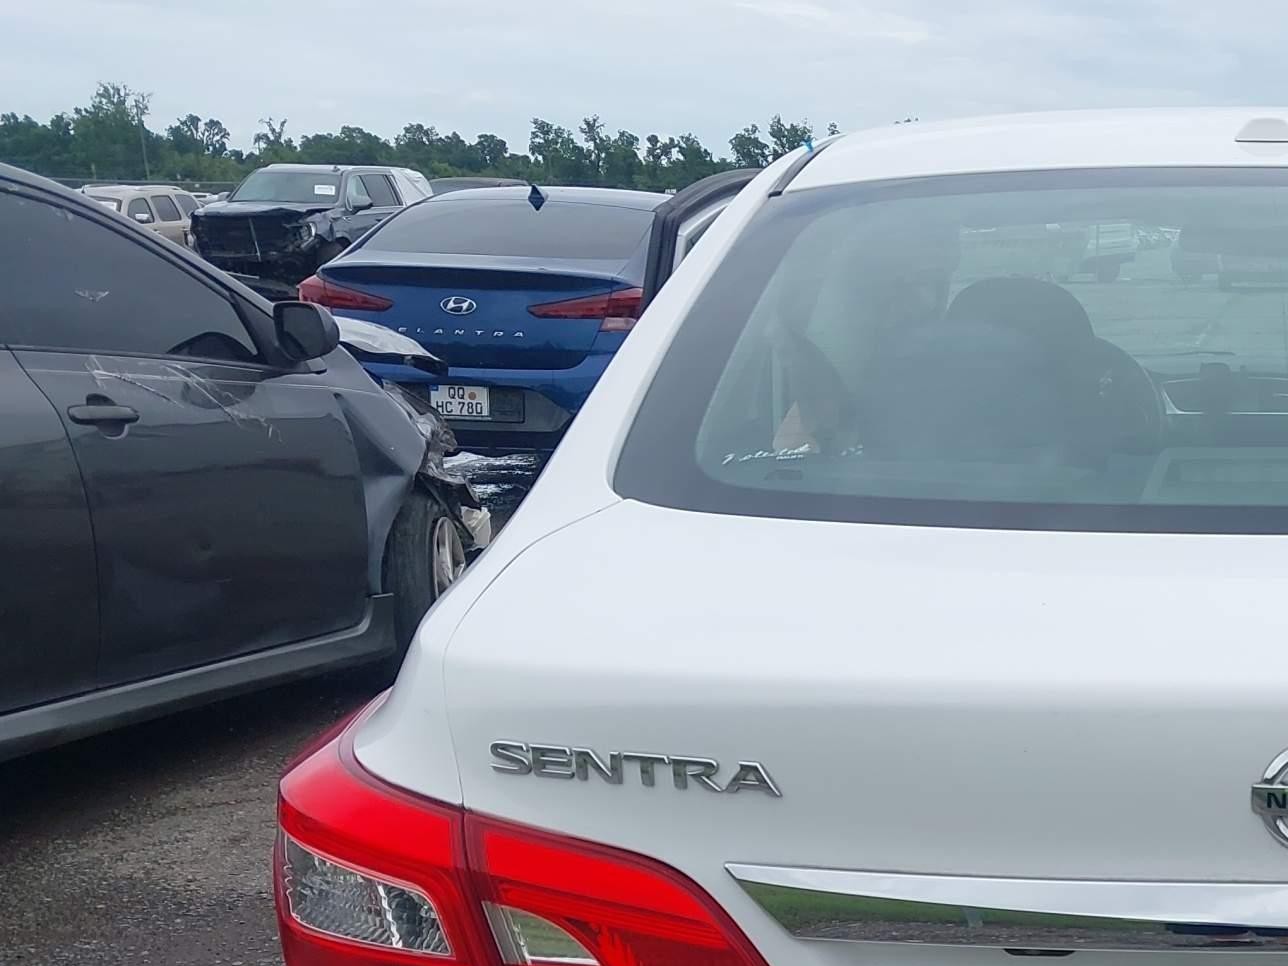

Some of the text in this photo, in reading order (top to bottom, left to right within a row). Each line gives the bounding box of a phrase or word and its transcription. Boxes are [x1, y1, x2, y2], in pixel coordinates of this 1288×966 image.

[398, 327, 524, 337] ELANTRA
[448, 386, 465, 400] QQ
[436, 400, 483, 415] HC 780
[489, 740, 783, 798] SENTRA
